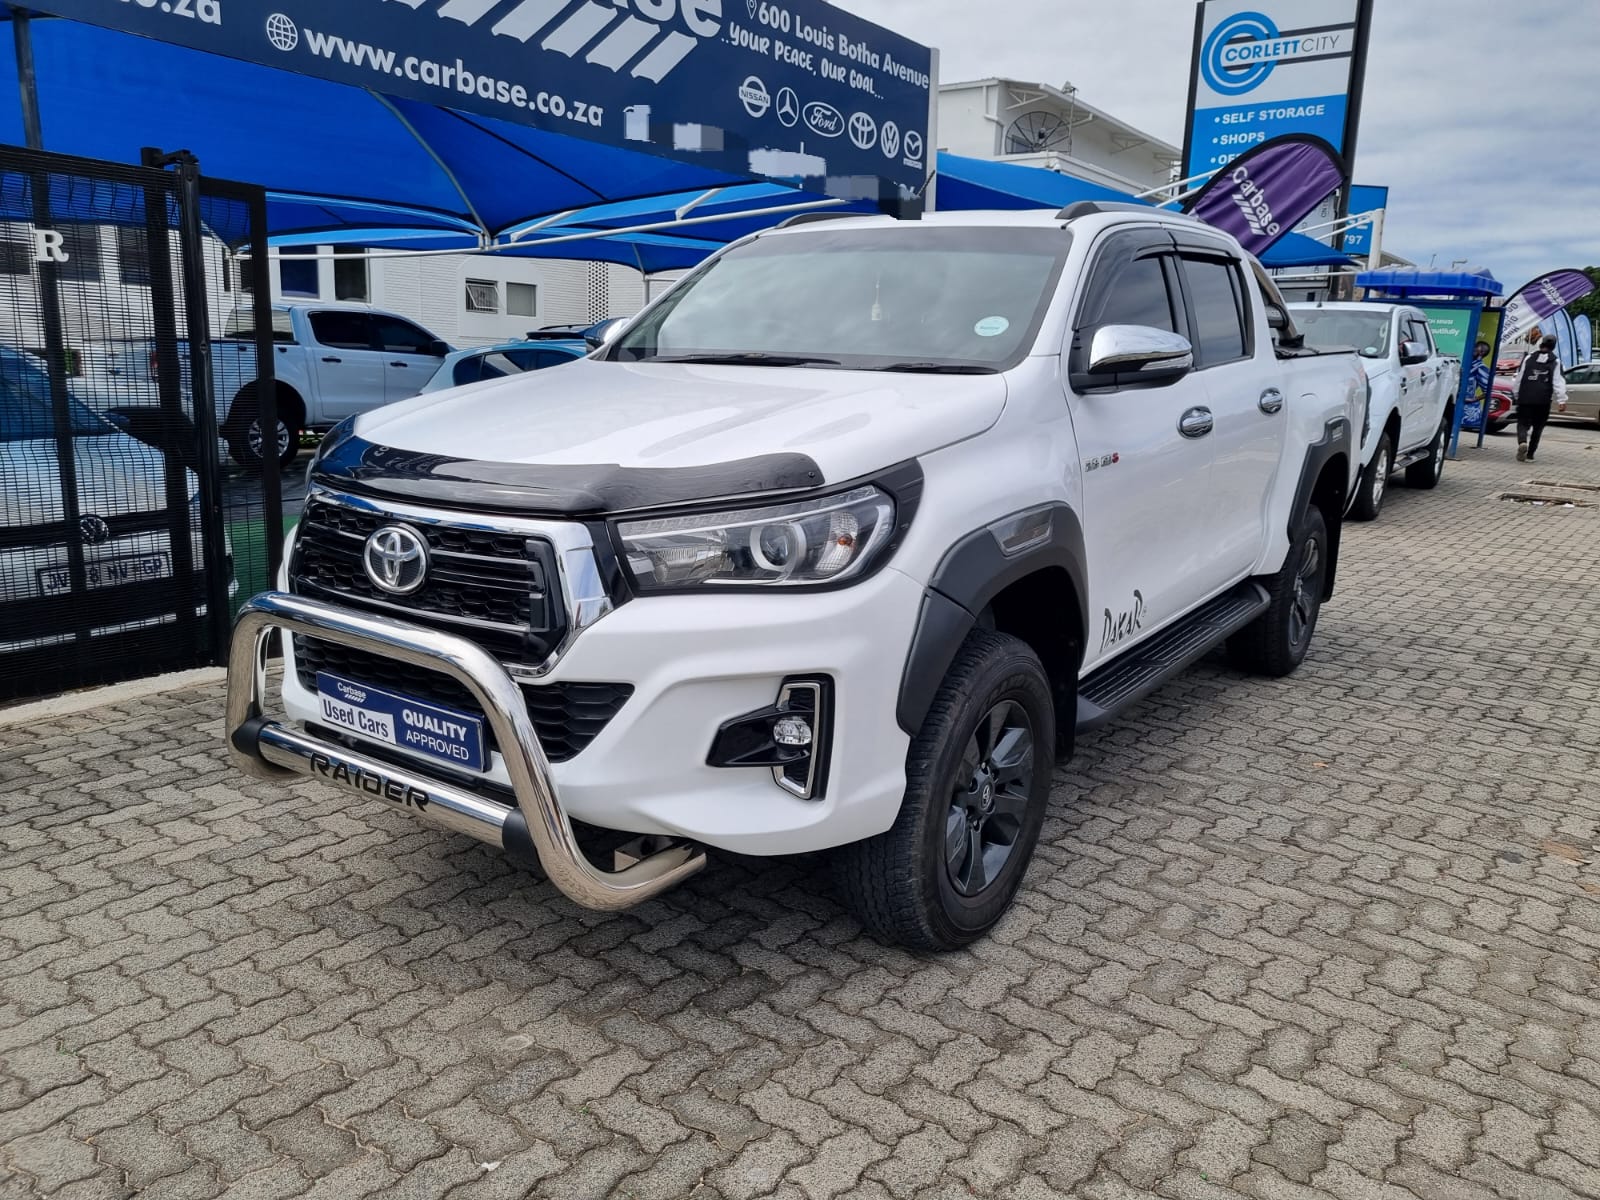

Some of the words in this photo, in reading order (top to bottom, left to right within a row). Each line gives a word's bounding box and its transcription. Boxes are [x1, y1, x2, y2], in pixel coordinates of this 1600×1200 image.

[758, 5, 791, 33] 600
[796, 16, 835, 51] Louis
[838, 35, 880, 70] Botha
[883, 53, 930, 89] Avenue
[774, 41, 817, 77] PEACE,
[820, 58, 847, 84] OUR
[304, 28, 604, 127] www.carbase.co.za
[741, 89, 769, 105] NISSAN
[810, 106, 837, 131] Ford
[1222, 111, 1255, 125] SELF
[1259, 104, 1325, 121] STORAGE
[1220, 131, 1265, 146] SHOPS
[1231, 166, 1281, 236] Carbase
[32, 229, 69, 263] R
[337, 682, 367, 699] Carbase
[322, 699, 355, 726] Used
[358, 710, 389, 738] Cars
[402, 708, 468, 742] QUALITY
[406, 729, 469, 761] APPROVED
[310, 752, 430, 812] RAIDER
